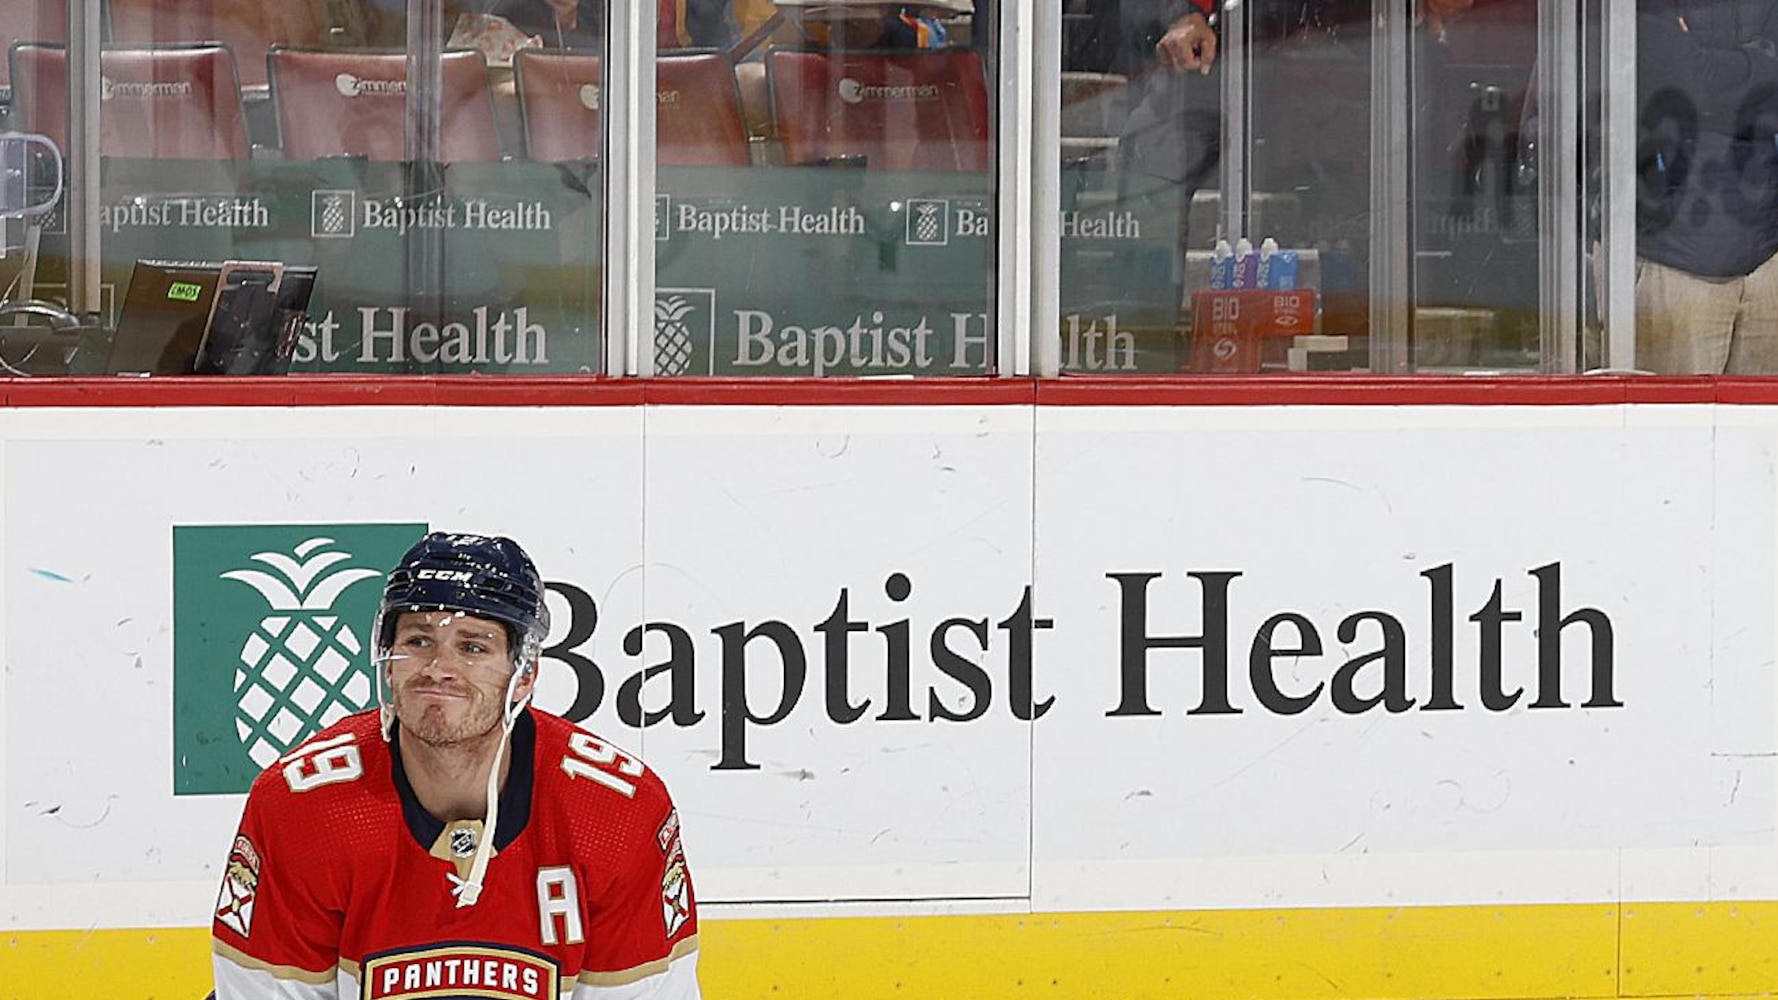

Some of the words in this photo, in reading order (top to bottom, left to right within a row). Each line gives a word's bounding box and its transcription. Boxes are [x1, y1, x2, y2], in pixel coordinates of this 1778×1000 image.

[100, 199, 172, 232] aptist
[179, 199, 269, 227] Health
[363, 200, 456, 236] Baptist
[463, 201, 551, 230] Health
[677, 204, 772, 239] Baptist
[777, 206, 865, 235] Health
[1059, 210, 1140, 239] Health
[357, 306, 549, 364] Health
[732, 310, 933, 377] Baptist
[417, 569, 474, 583] CCM
[1104, 561, 1624, 717] Health
[279, 733, 364, 792] 19
[560, 732, 645, 799] 19
[537, 866, 584, 945] A
[383, 959, 539, 995] PANTHERS
